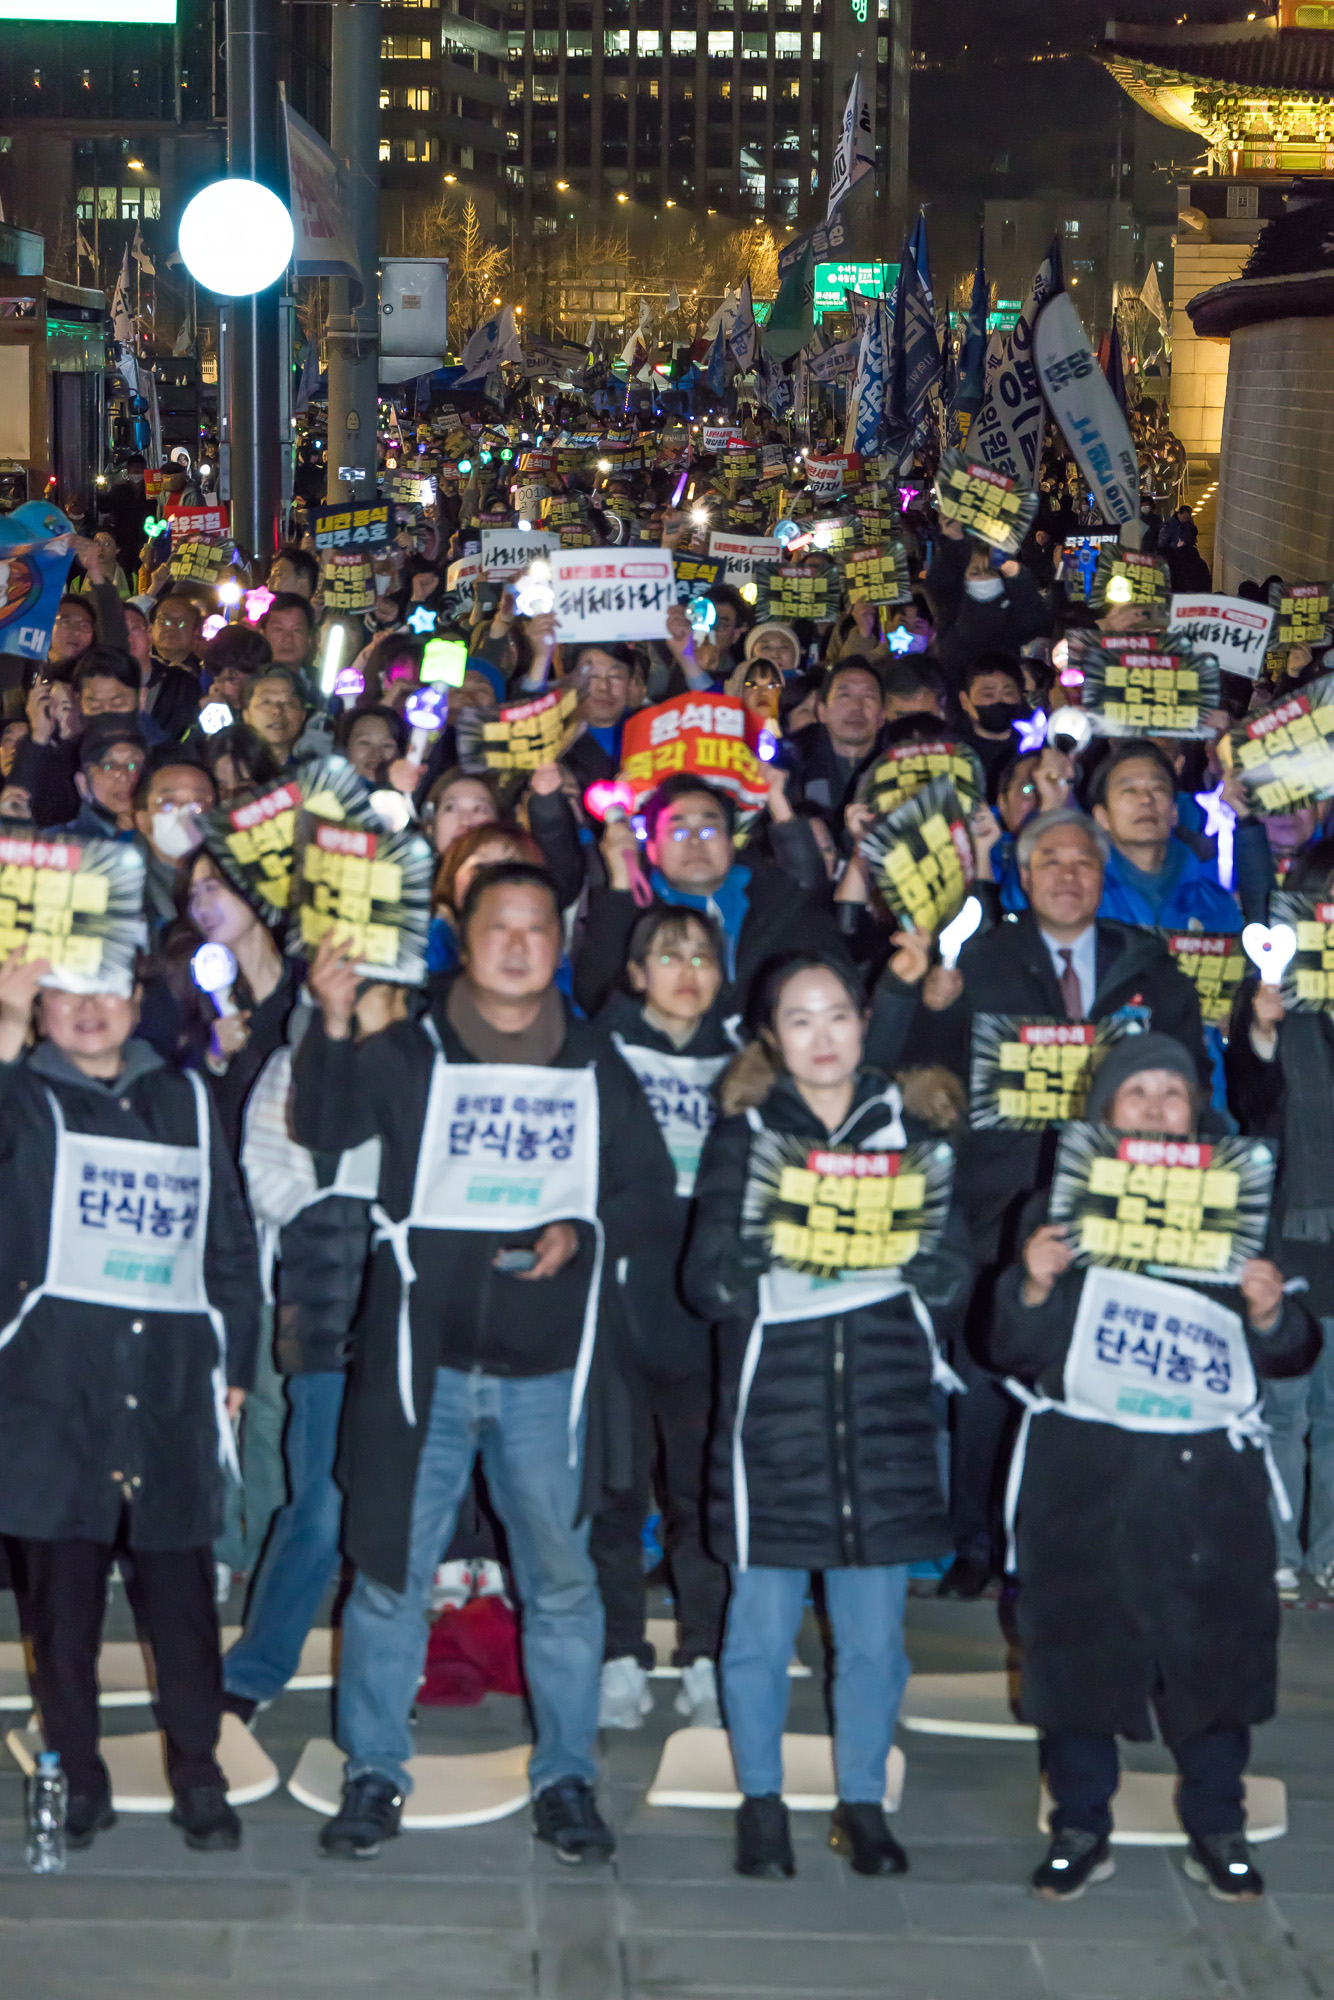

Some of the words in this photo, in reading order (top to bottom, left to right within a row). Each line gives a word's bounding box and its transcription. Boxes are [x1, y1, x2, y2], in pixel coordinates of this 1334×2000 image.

[18, 626, 46, 652] 대
[650, 702, 746, 746] 윤석열
[450, 1120, 576, 1162] 단식농성
[1096, 1325, 1232, 1395] 단식농성
